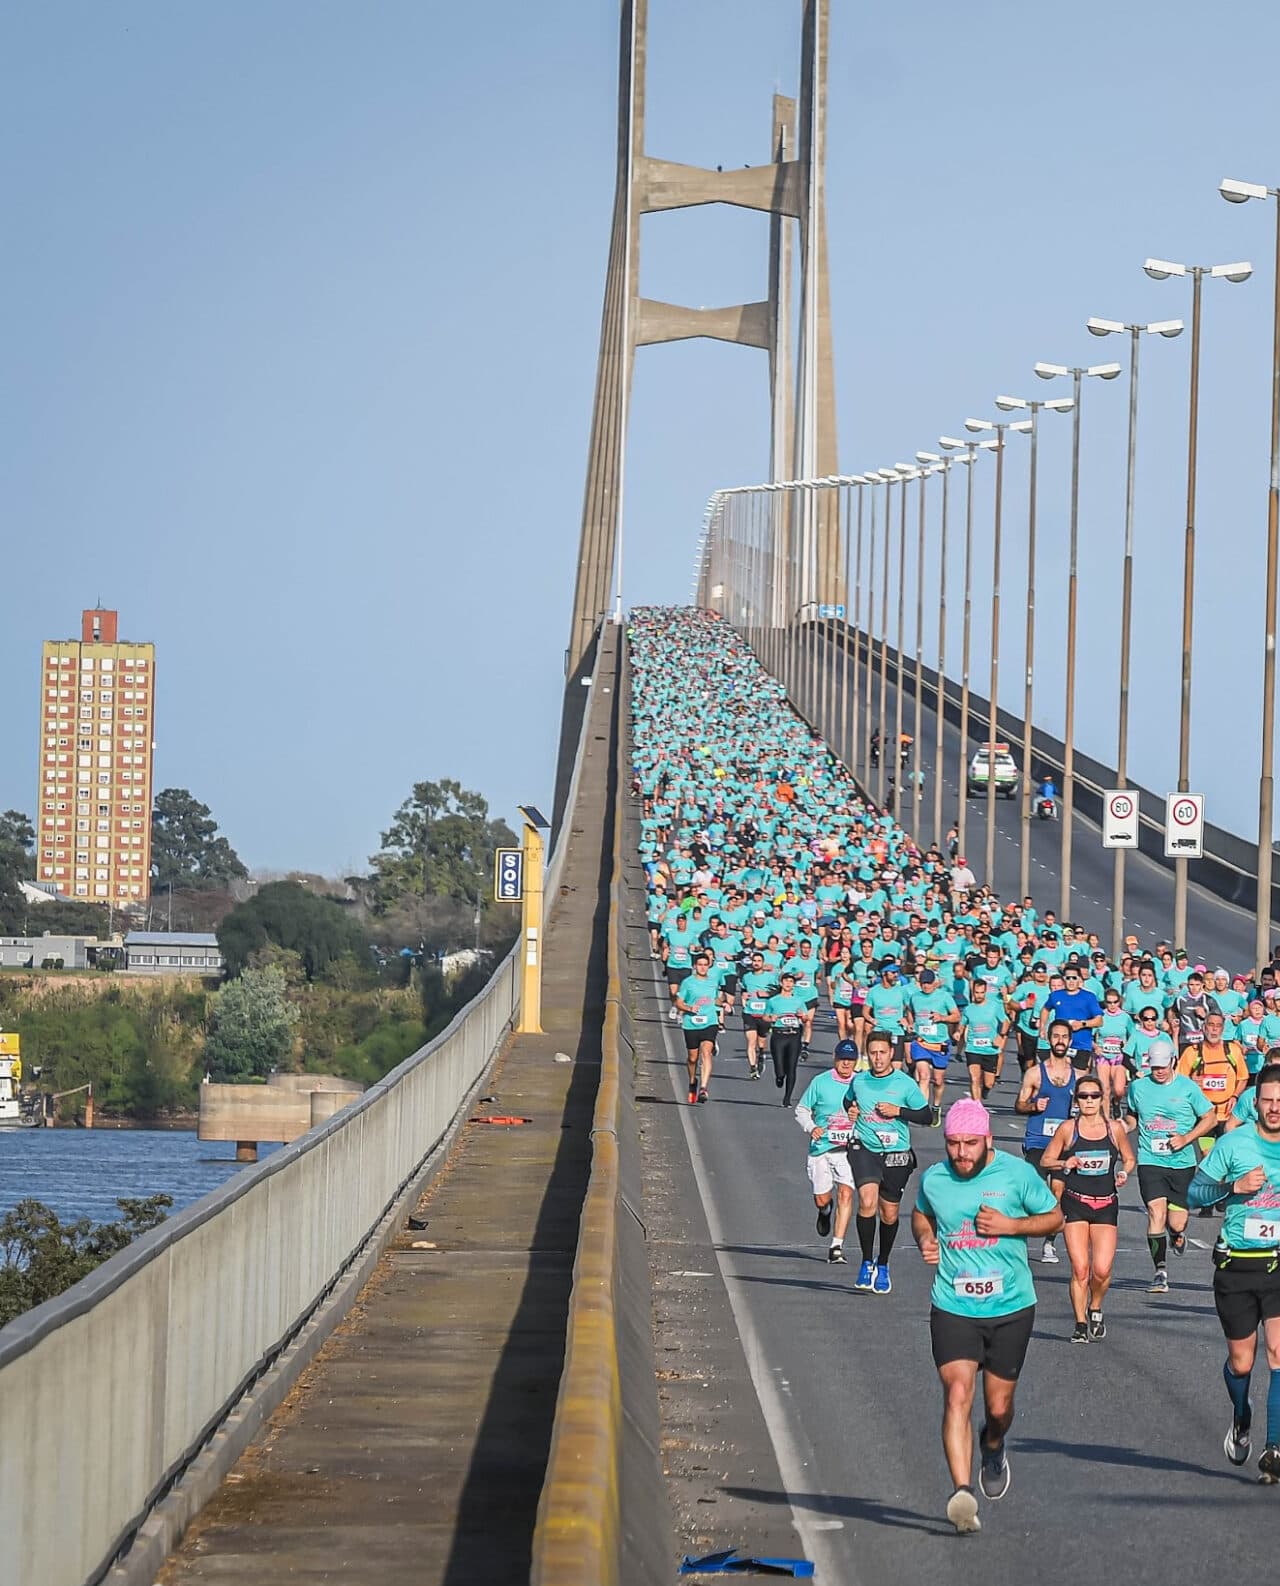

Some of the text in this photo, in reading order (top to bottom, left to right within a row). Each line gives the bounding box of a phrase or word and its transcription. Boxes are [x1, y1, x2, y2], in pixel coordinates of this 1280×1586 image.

[1115, 802, 1129, 813] 80
[1178, 806, 1193, 818] 60
[504, 854, 519, 896] SOS
[1205, 1079, 1225, 1089] 4015
[1083, 1159, 1105, 1170] 637
[1259, 1224, 1276, 1238] 21
[964, 1281, 994, 1295] 658
